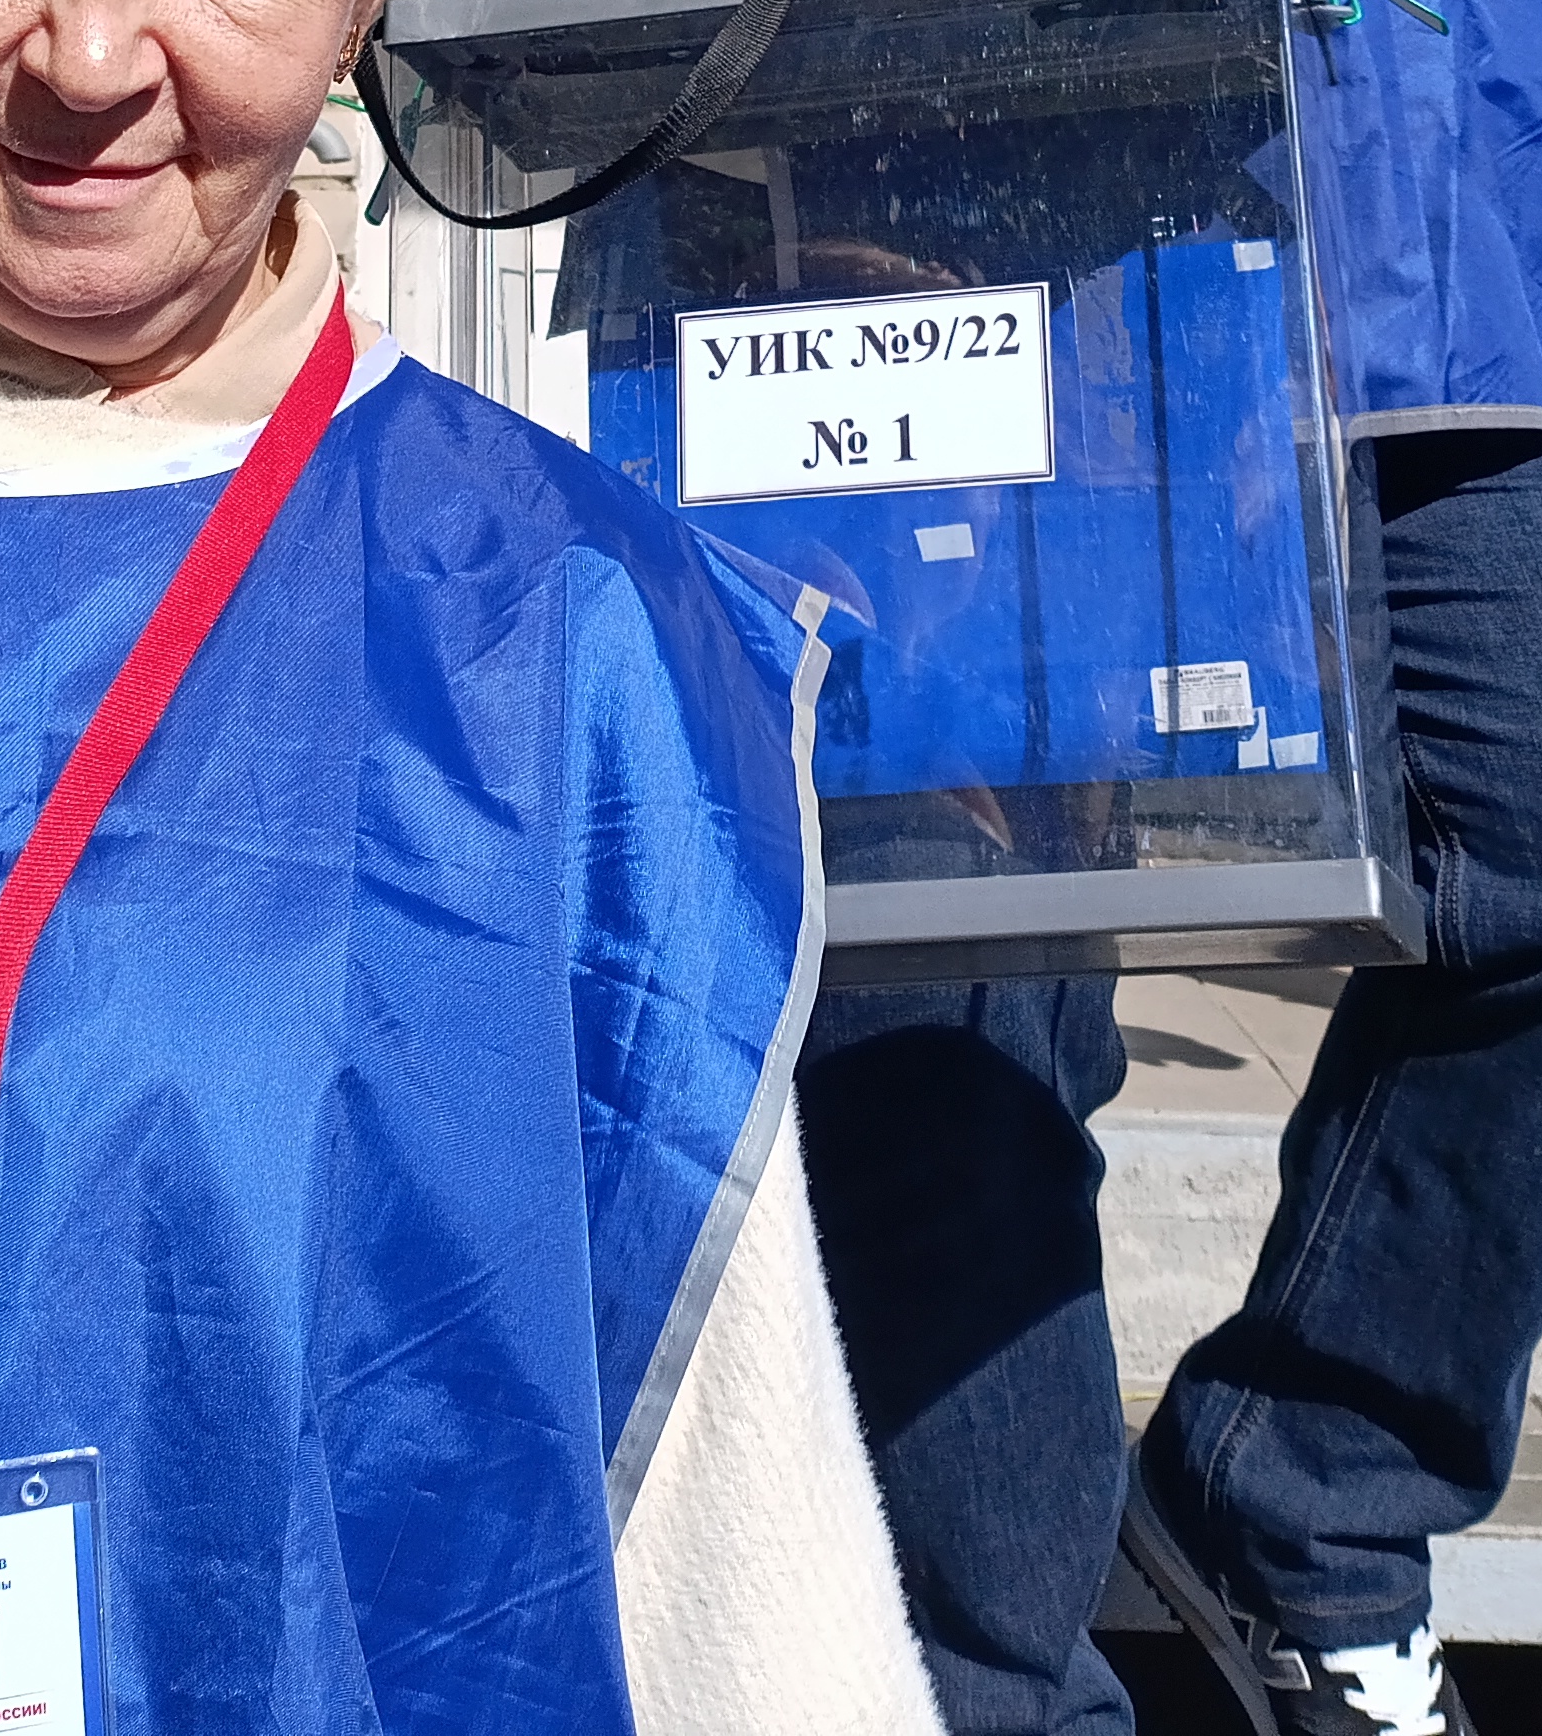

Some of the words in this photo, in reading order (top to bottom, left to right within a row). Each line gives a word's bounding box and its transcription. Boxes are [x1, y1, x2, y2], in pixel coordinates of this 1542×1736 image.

[700, 327, 834, 381] УИК
[849, 312, 1021, 368] №9/22
[801, 417, 869, 470] №
[892, 413, 918, 463] 1
